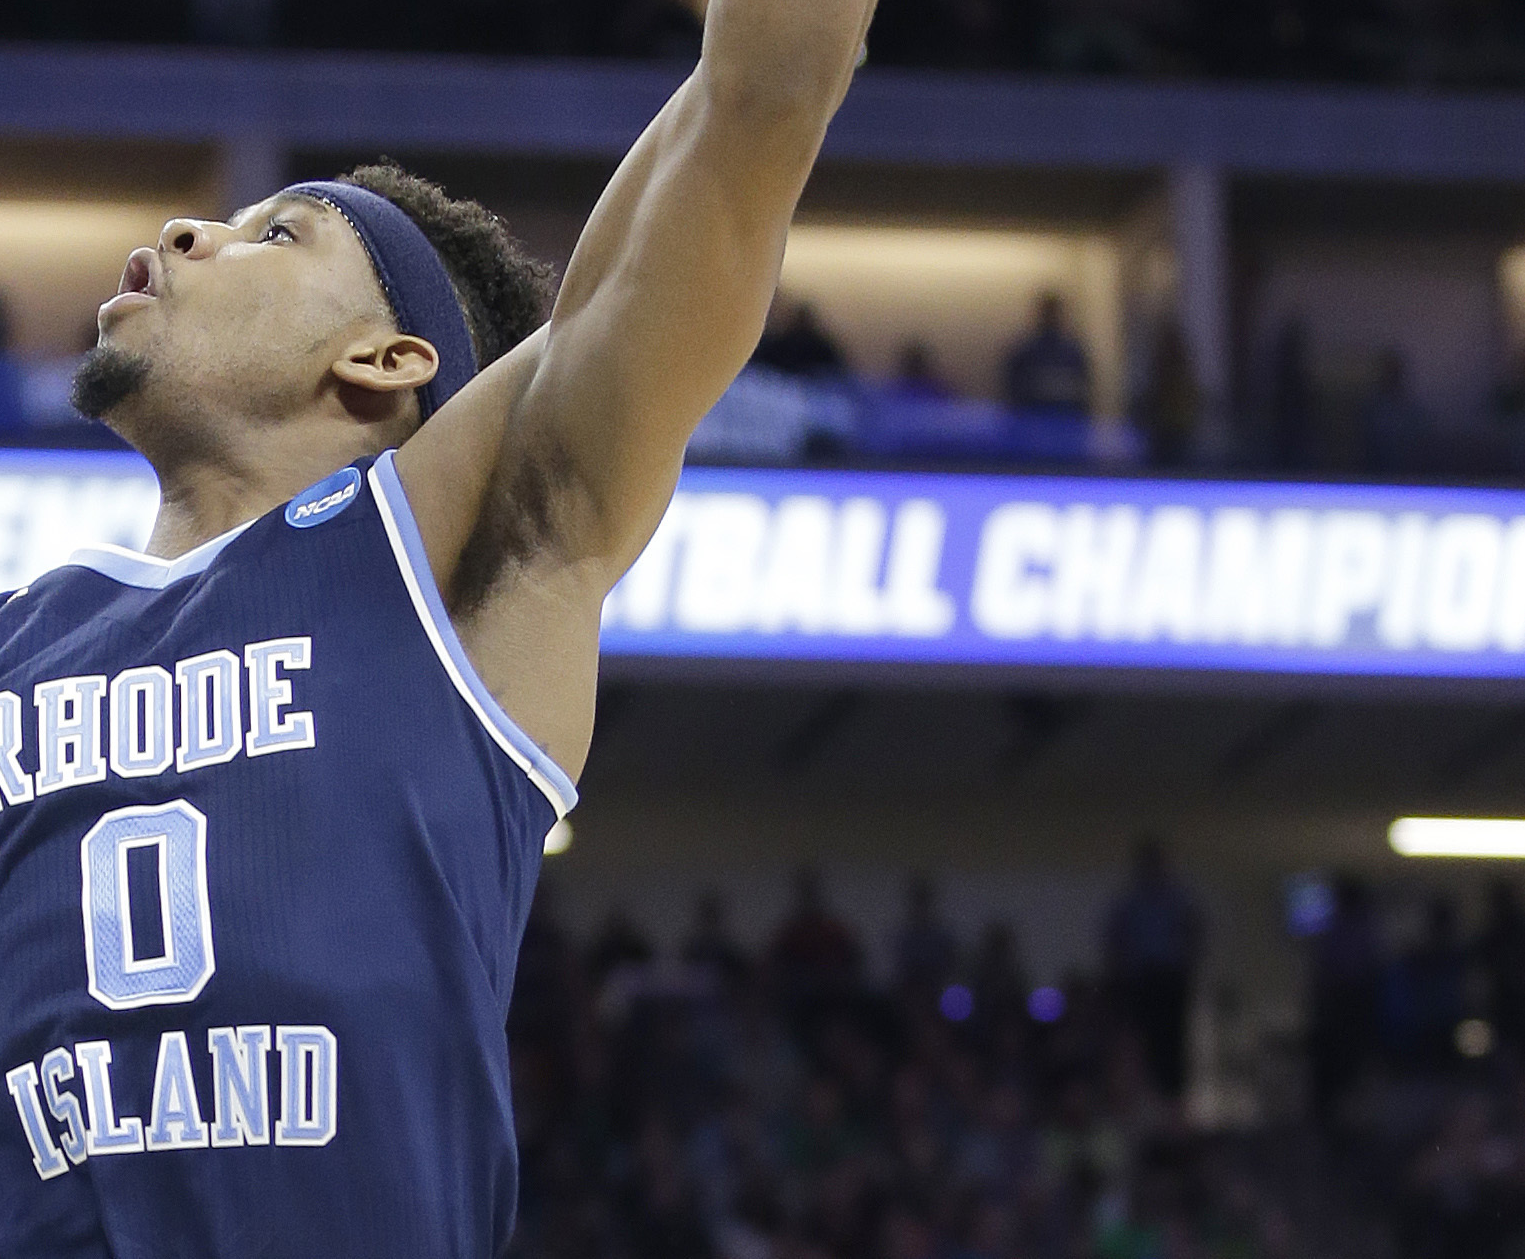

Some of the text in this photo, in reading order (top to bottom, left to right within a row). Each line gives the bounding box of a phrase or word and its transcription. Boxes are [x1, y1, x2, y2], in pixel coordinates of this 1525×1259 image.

[293, 480, 356, 520] NCAA
[600, 490, 954, 639] TBALL
[81, 799, 215, 1010] 0
[6, 1024, 337, 1180] ISLAND
